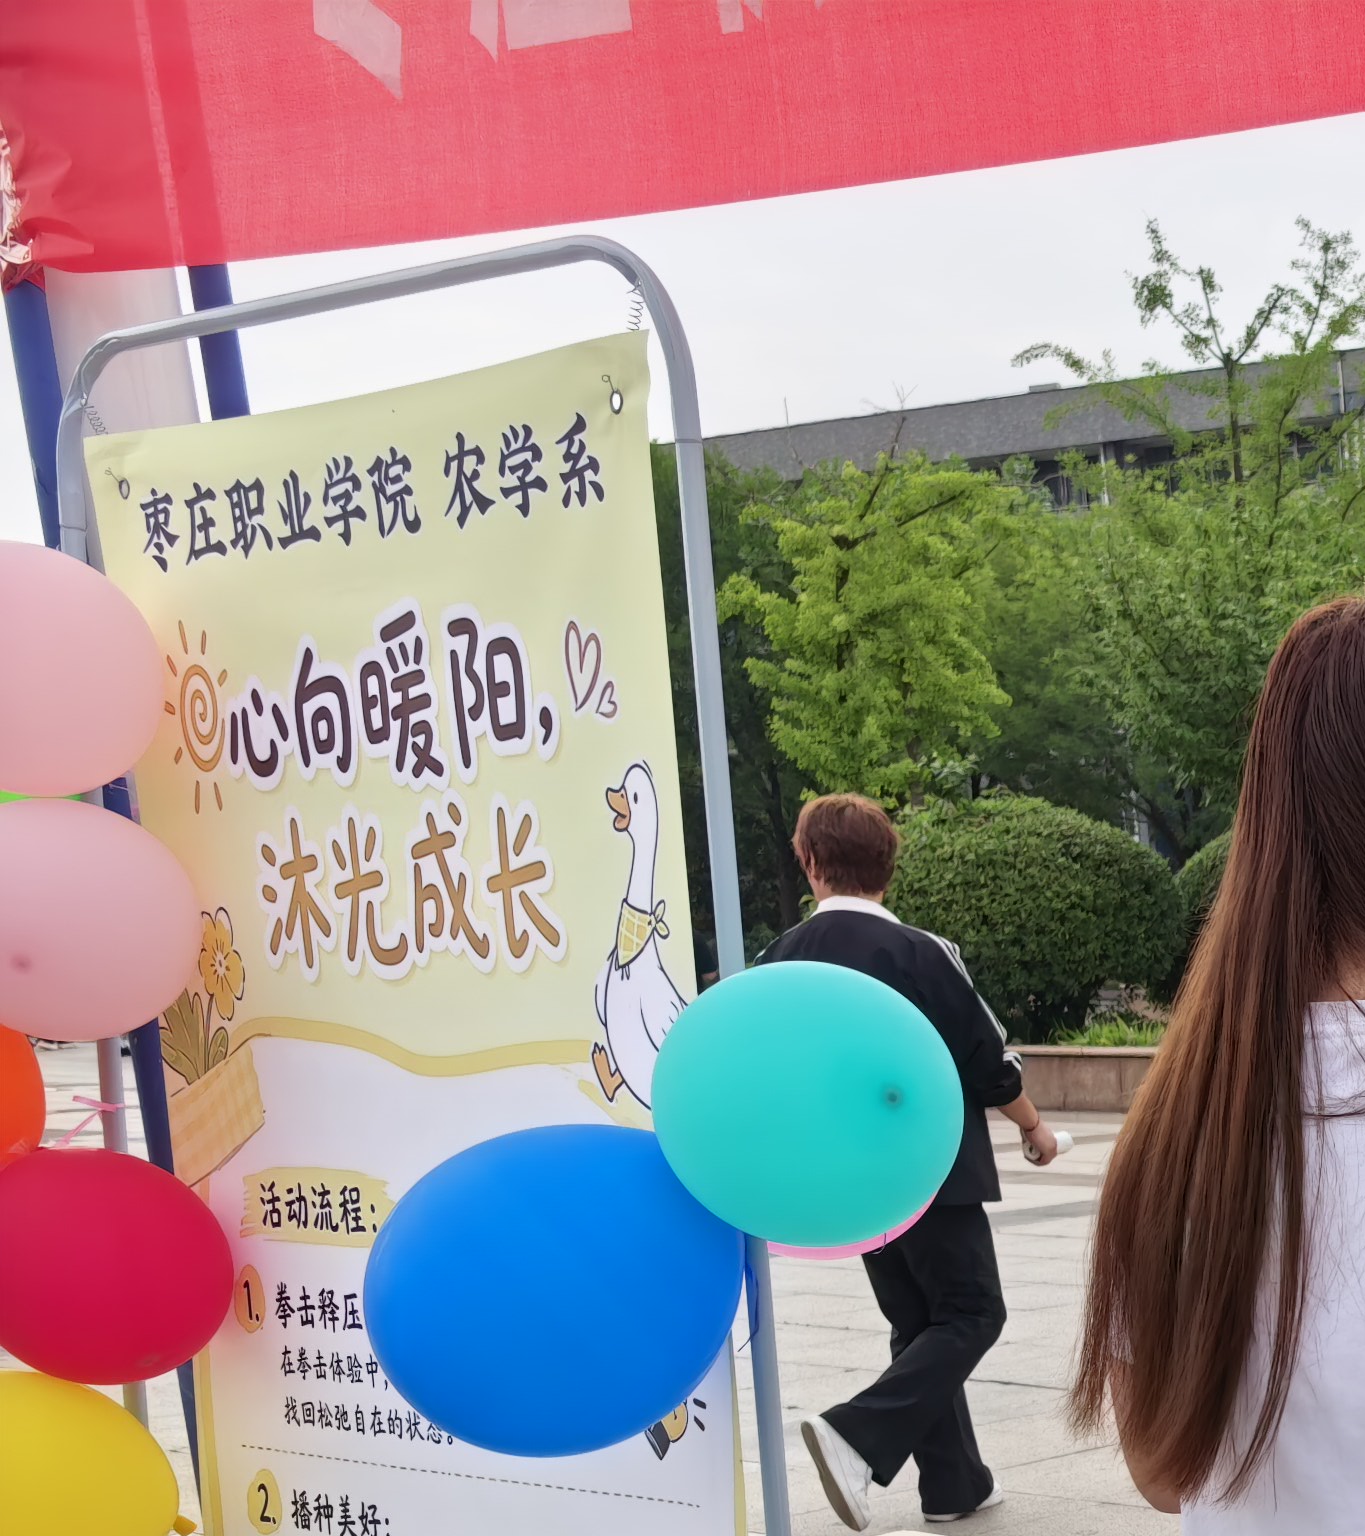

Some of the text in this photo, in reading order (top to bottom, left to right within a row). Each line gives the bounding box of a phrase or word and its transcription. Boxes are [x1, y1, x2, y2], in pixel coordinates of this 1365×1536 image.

[141, 411, 605, 572] 枣庄职业学院 农学系
[259, 800, 563, 970] 沐光成长
[259, 1180, 379, 1235] 活动流程：
[242, 1279, 260, 1323] 1.
[257, 1482, 277, 1525] 2.
